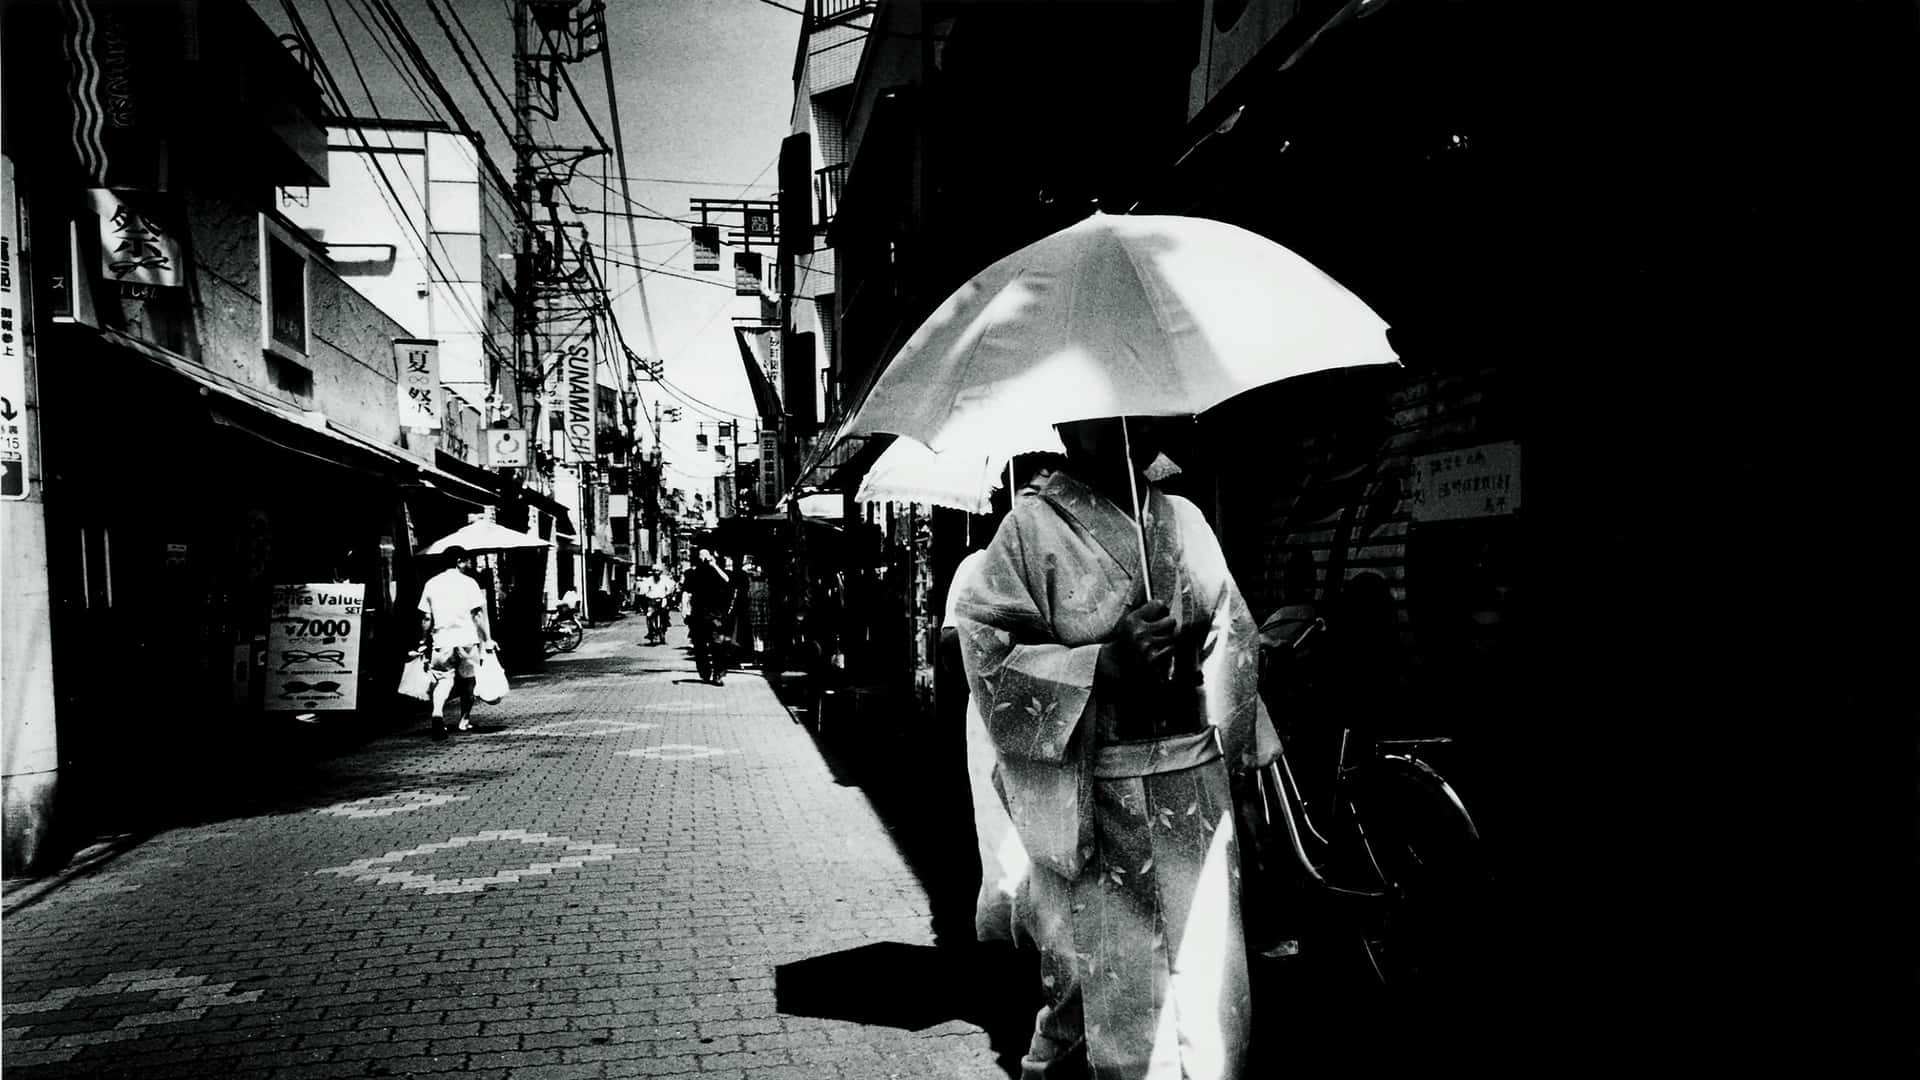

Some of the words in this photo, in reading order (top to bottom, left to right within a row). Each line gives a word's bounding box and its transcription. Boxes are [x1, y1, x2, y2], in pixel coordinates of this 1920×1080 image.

[568, 345, 591, 455] SUNAMACHI
[317, 593, 362, 606] Value
[344, 606, 361, 615] SET
